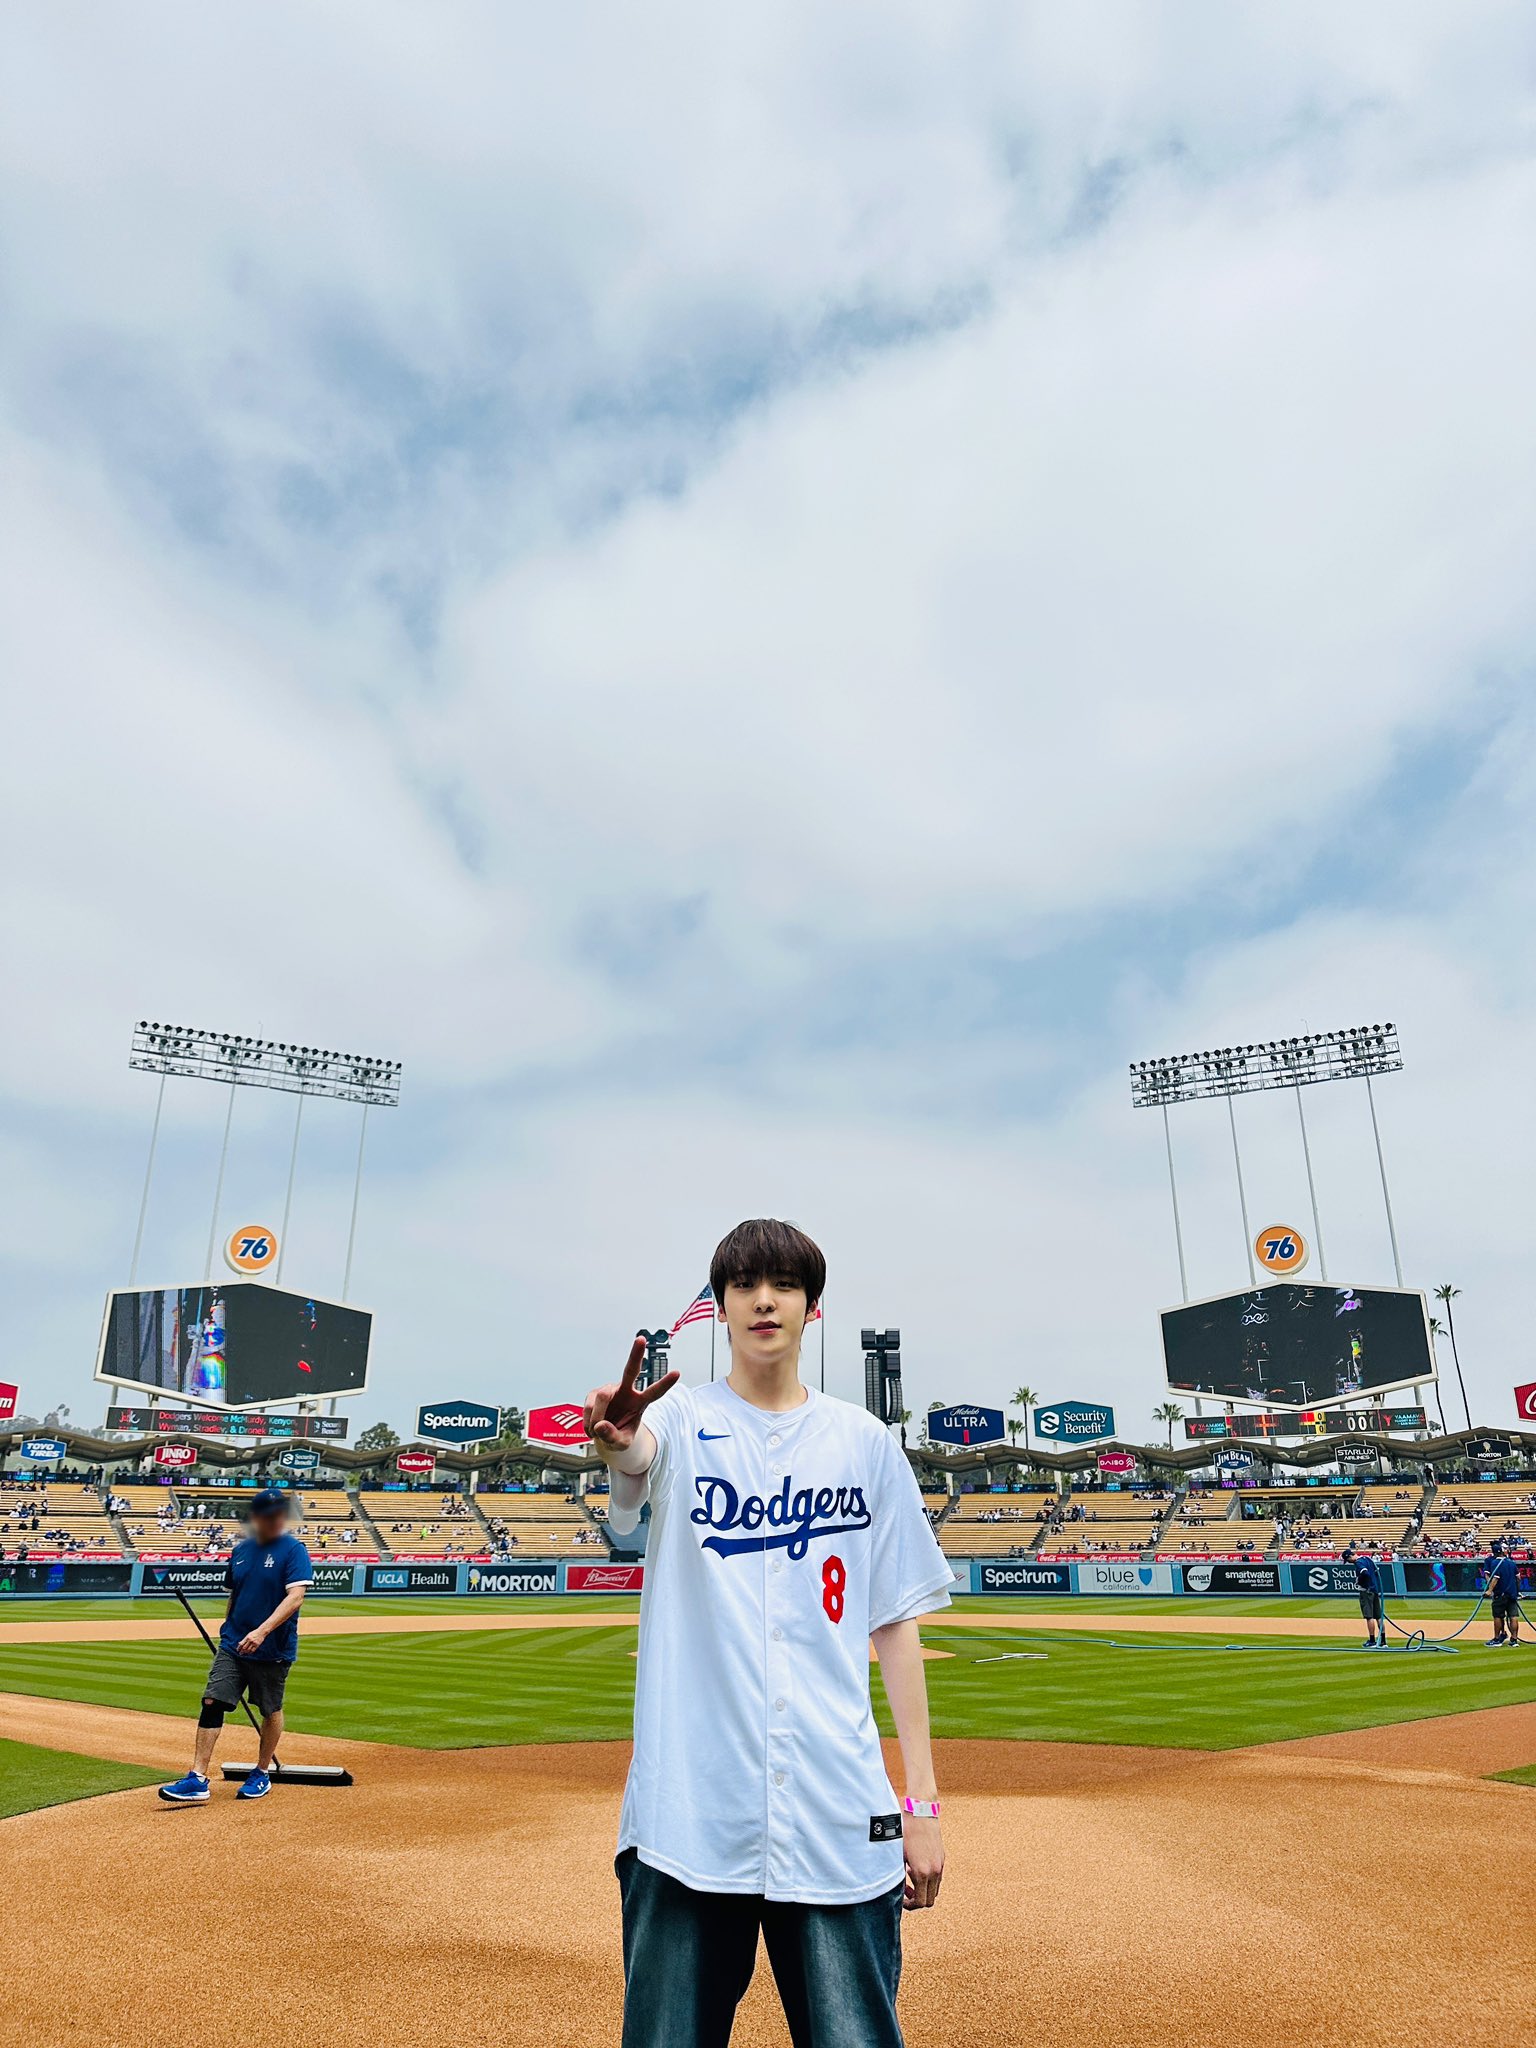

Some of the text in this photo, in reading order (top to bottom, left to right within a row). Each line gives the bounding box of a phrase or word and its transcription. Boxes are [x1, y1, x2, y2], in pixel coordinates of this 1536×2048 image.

[239, 1237, 269, 1259] 76
[1266, 1236, 1297, 1260] 76
[423, 1413, 490, 1429] Spectrum
[943, 1416, 988, 1428] ULTRA
[1063, 1410, 1107, 1424] Security
[229, 1425, 237, 1434] &
[1064, 1423, 1105, 1434] Benefit
[161, 1448, 191, 1461] JINRO
[1217, 1453, 1230, 1467] JIM
[1230, 1450, 1251, 1465] BEAM
[690, 1475, 872, 1561] Dodgers
[168, 1570, 226, 1582] vividseat
[377, 1573, 449, 1585] UCLA Health
[985, 1569, 1057, 1587] Spectrum
[1096, 1567, 1135, 1583] blue
[1188, 1573, 1210, 1581] smart
[1225, 1571, 1274, 1579] smartwater
[1331, 1567, 1357, 1578] Secu
[480, 1575, 556, 1592] MORTON
[822, 1554, 846, 1624] 8
[1103, 1583, 1140, 1591] california
